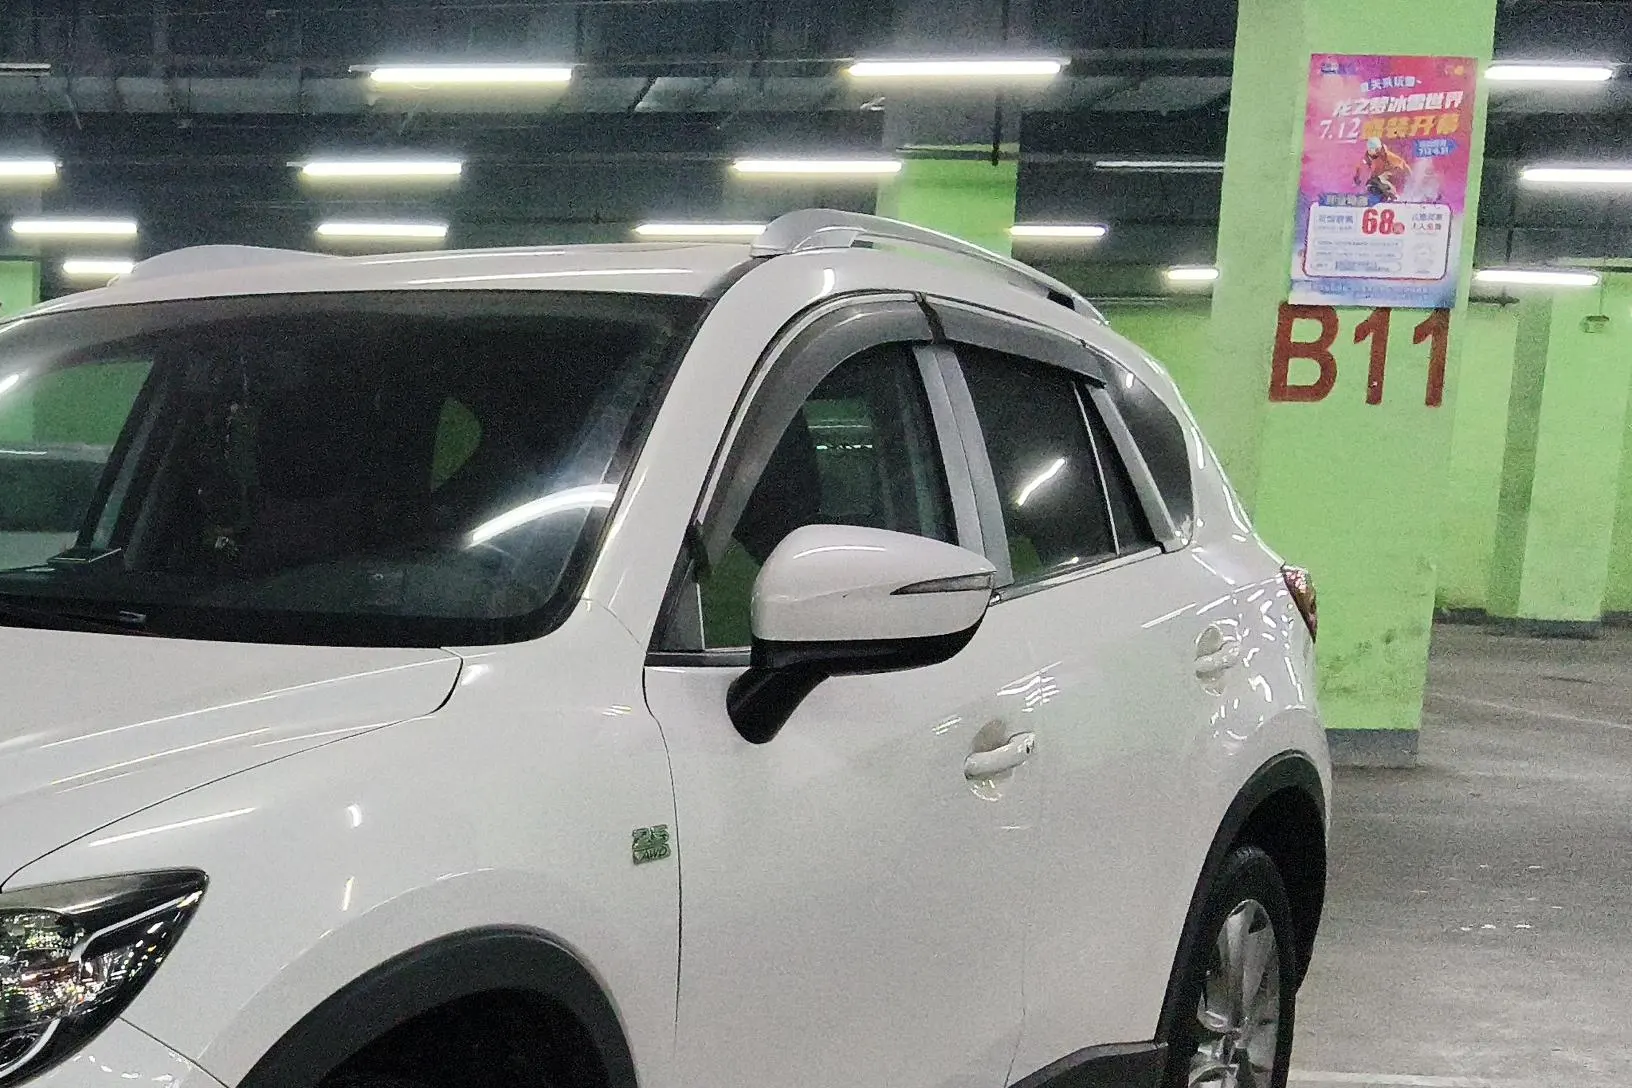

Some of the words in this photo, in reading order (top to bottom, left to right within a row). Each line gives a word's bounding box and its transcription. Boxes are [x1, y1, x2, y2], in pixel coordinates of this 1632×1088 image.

[1332, 90, 1464, 117] 龙之梦冰雪世界
[1319, 117, 1361, 144] 7.12
[1269, 303, 1450, 407] B11
[642, 846, 668, 860] AWD
